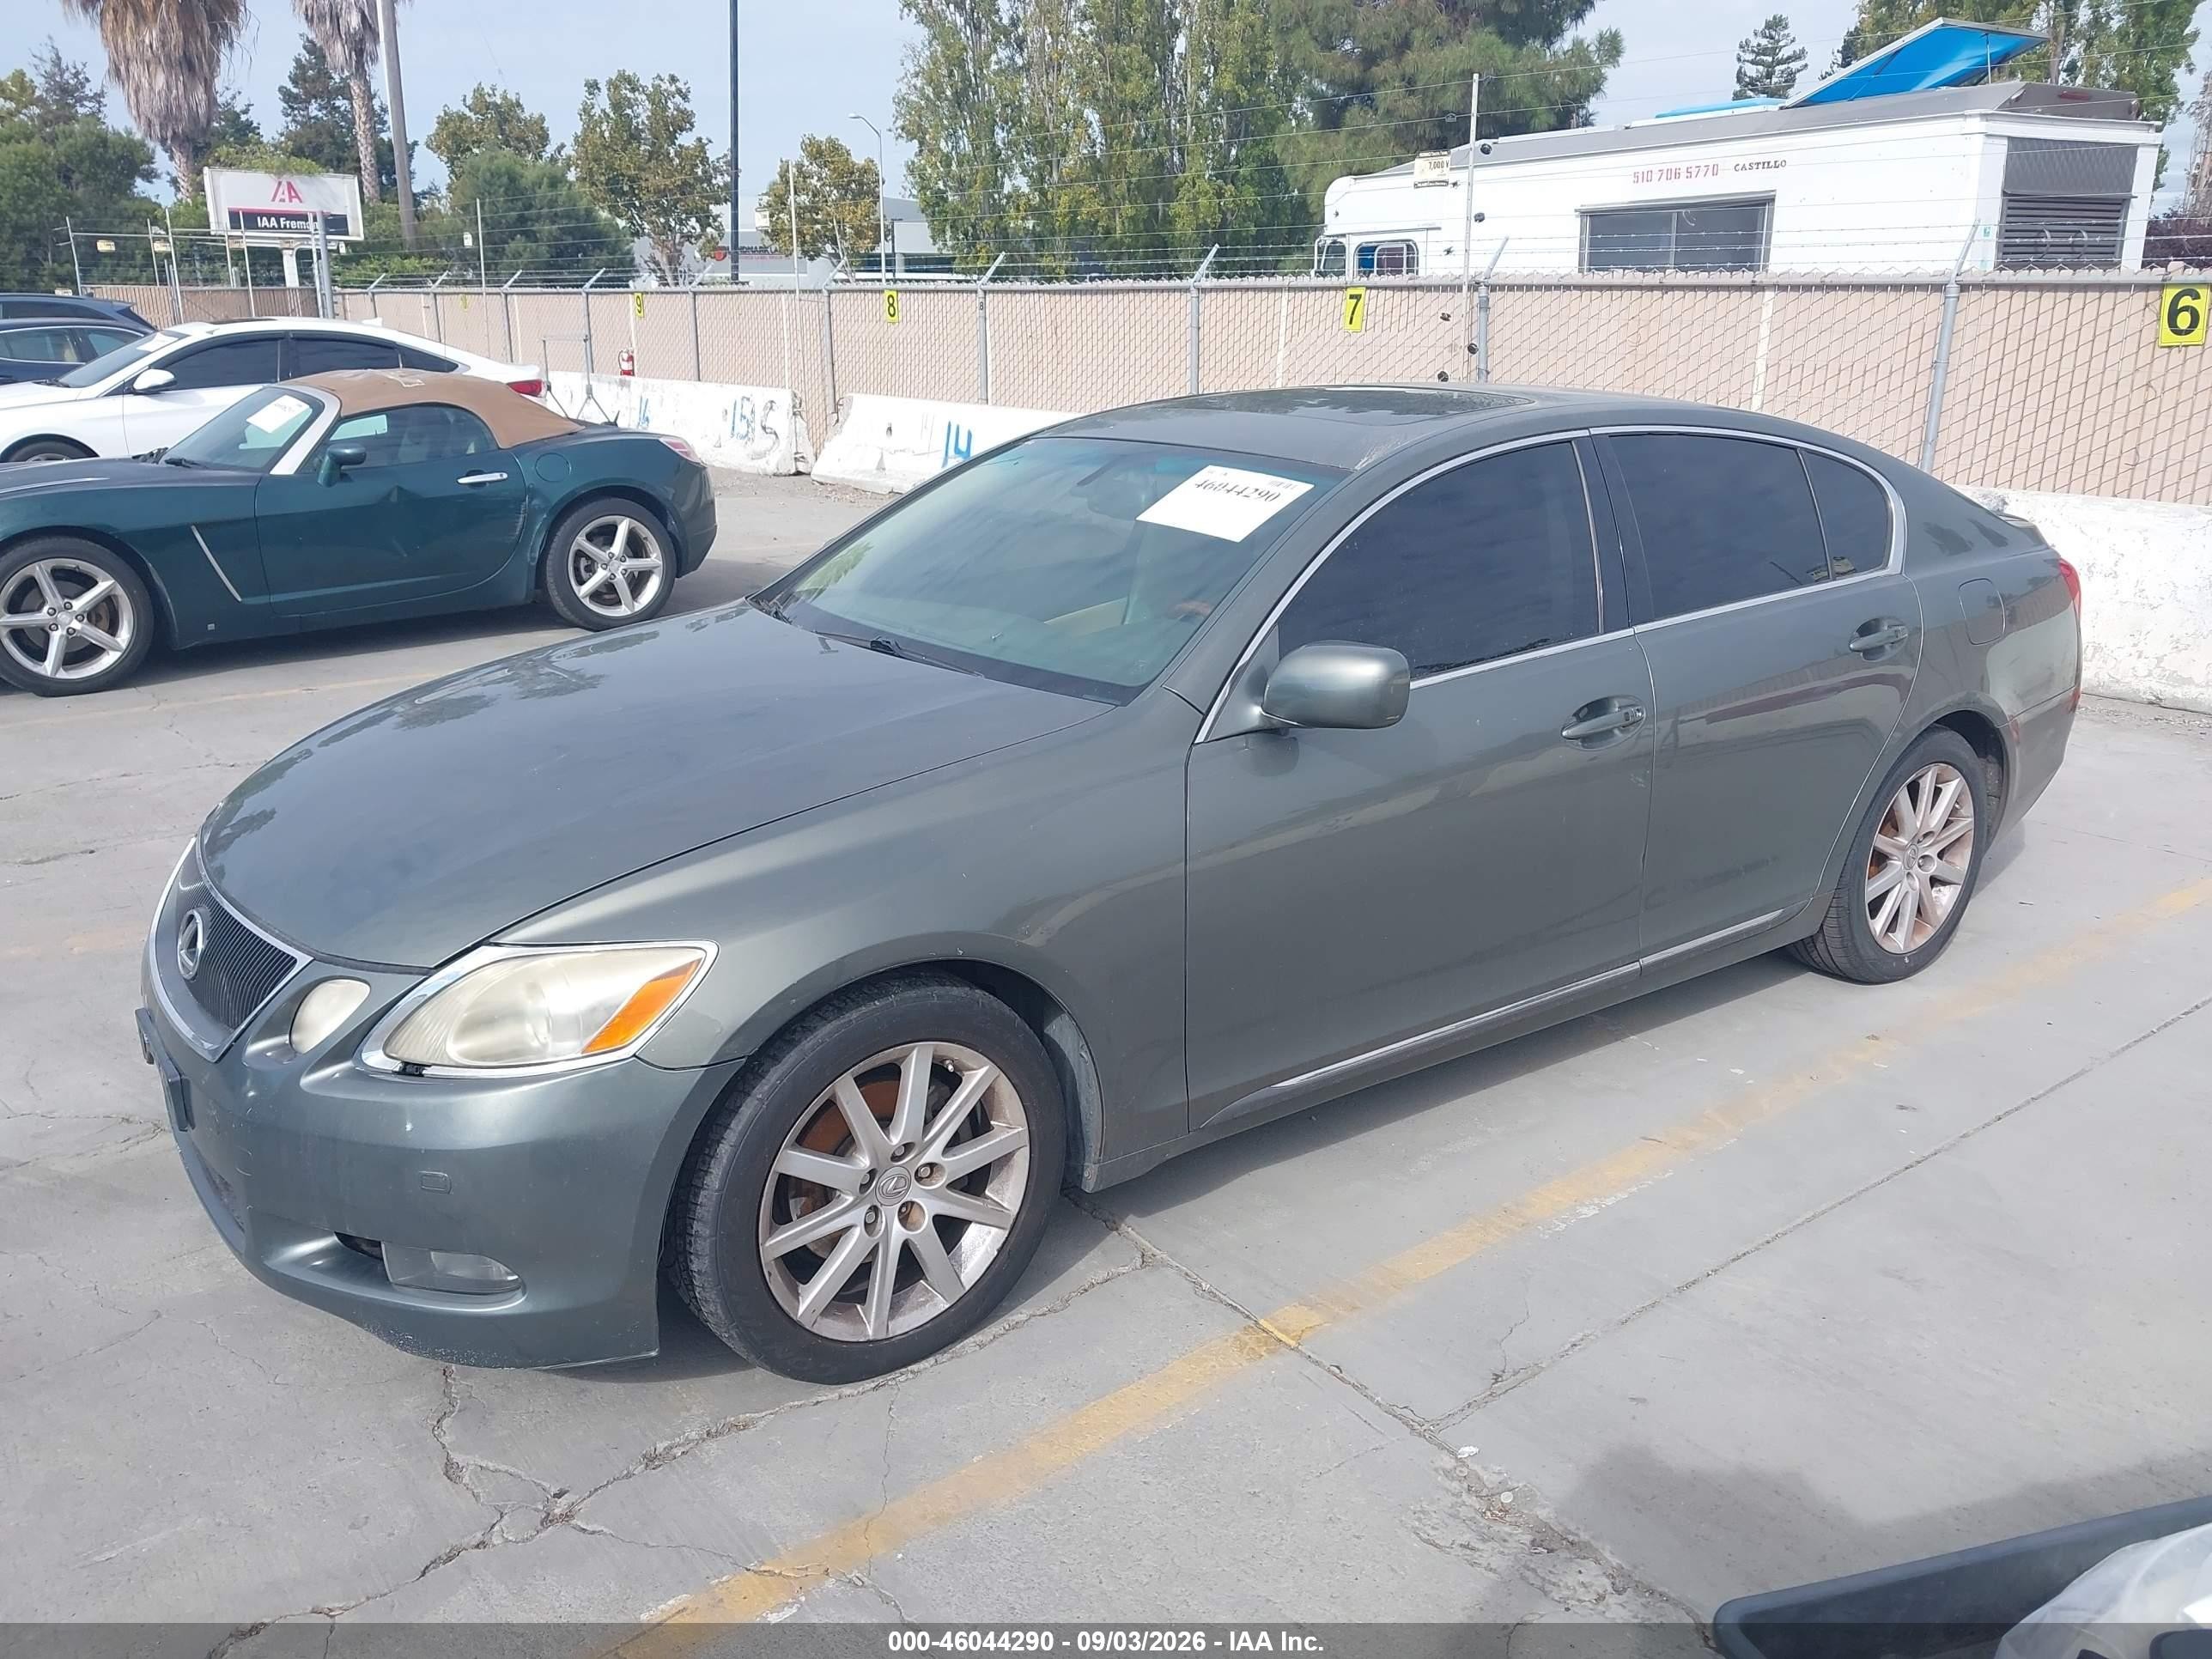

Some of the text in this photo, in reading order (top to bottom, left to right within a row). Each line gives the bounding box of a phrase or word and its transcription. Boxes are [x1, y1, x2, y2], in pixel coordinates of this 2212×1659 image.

[1633, 170, 1653, 184] 510
[1686, 163, 1719, 179] 5770
[1734, 159, 1787, 172] CASTILLO
[257, 216, 324, 230] IAA Fremon
[635, 295, 642, 314] 9
[887, 294, 896, 318] 8
[979, 301, 984, 311] 8
[1348, 294, 1363, 325] 7
[2166, 288, 2202, 337] 6
[940, 421, 973, 469] 14
[1194, 478, 1281, 502] 46044290
